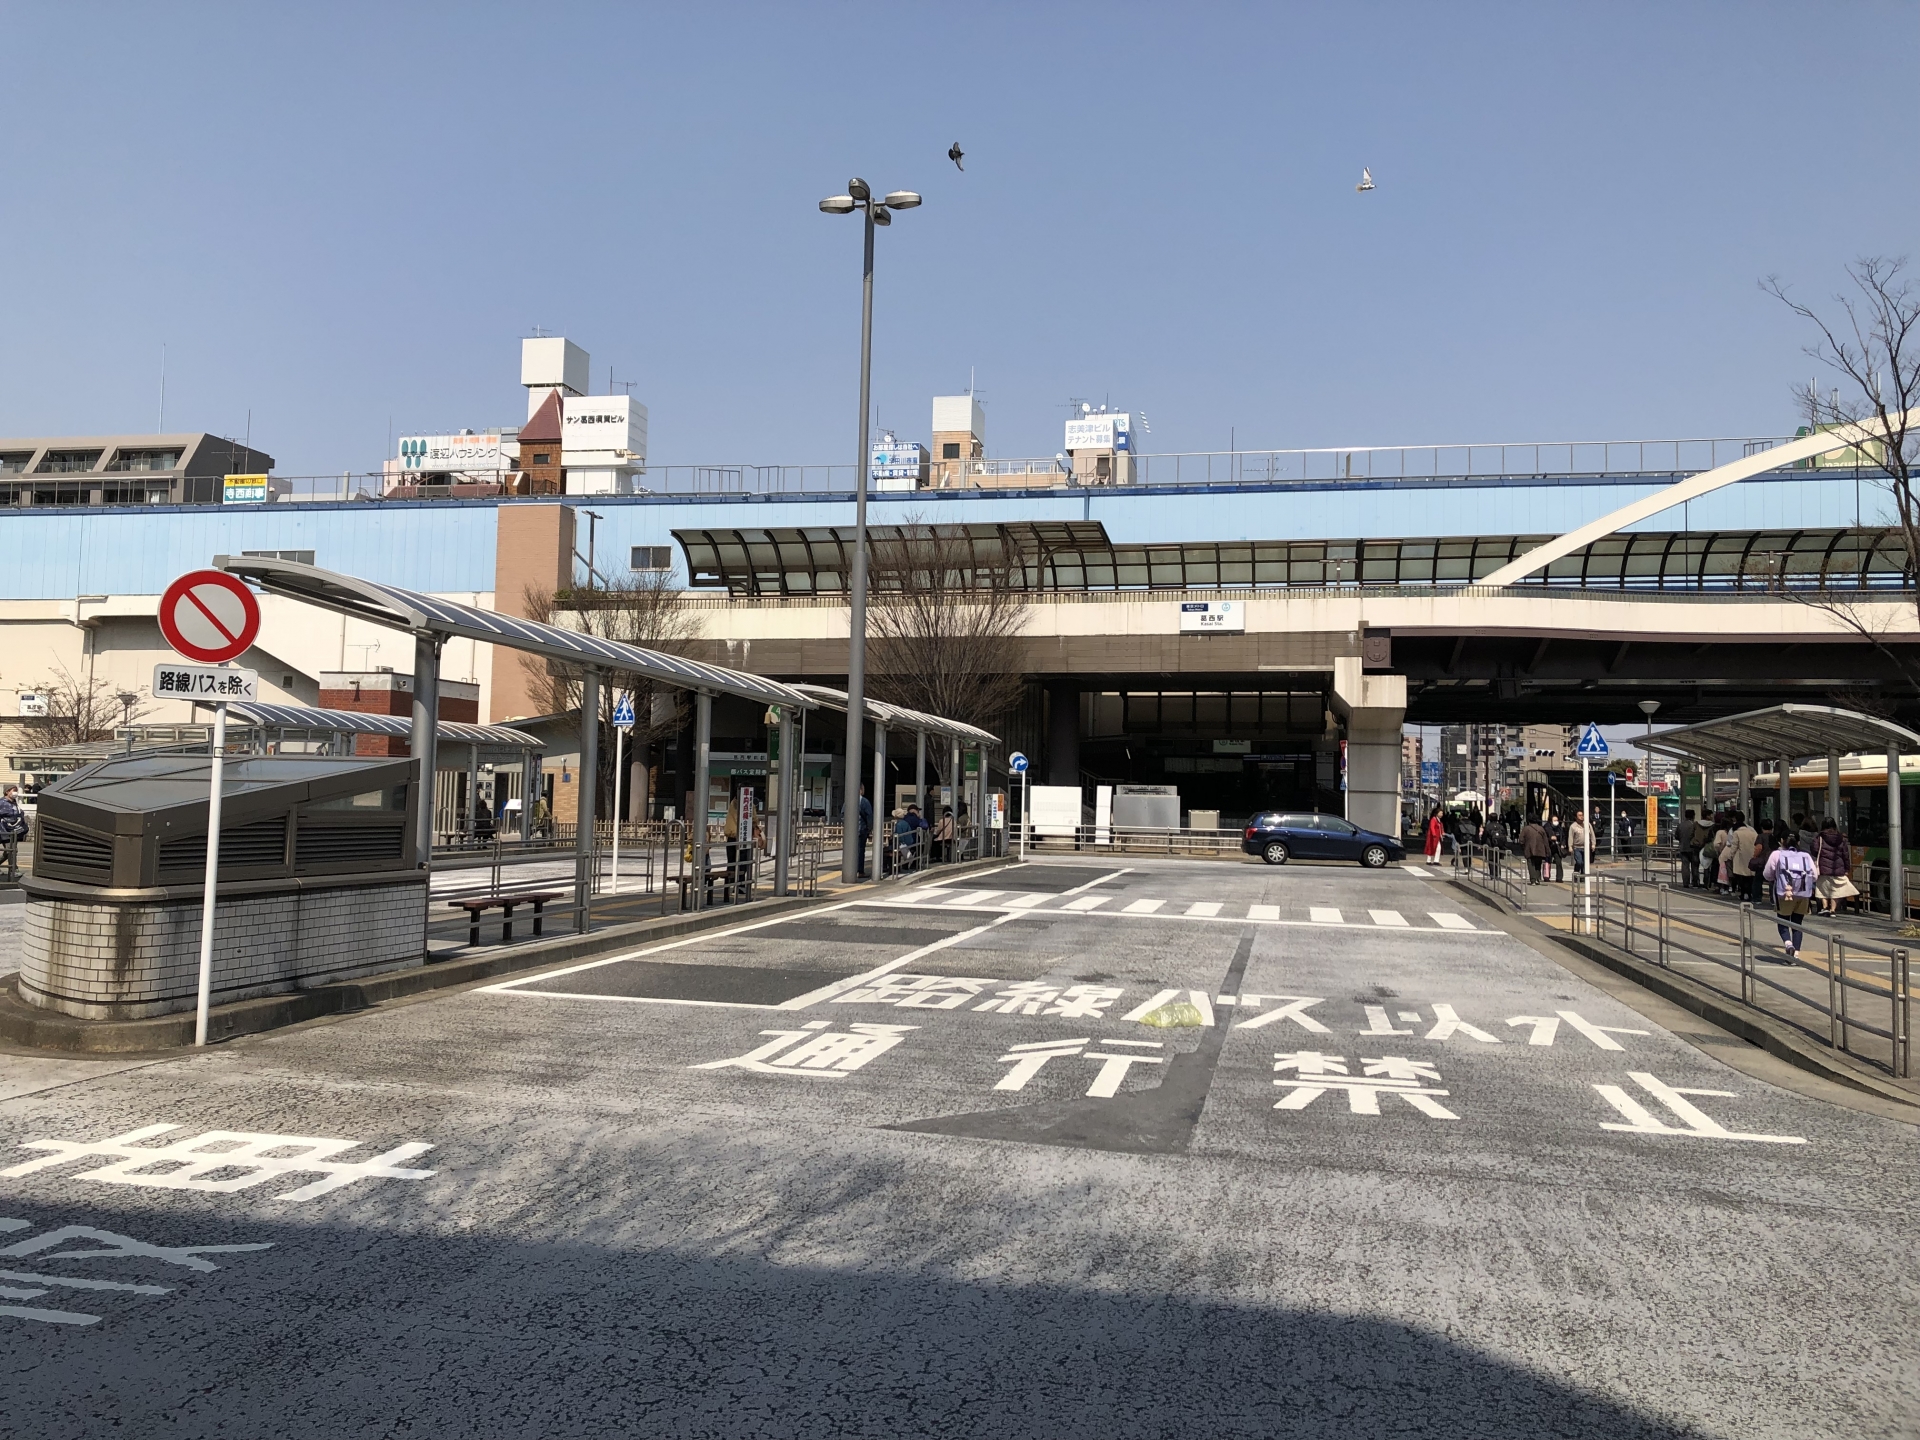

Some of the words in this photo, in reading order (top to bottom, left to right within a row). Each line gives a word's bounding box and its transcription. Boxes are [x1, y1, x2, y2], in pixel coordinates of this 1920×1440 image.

[1068, 424, 1111, 434] 志美津ビル
[1068, 434, 1111, 444] テナント募集
[430, 447, 498, 459] 渡辺ハウジング
[225, 487, 265, 499] 寺西商事
[1200, 614, 1224, 622] 葛西駅
[158, 670, 253, 697] 路線バスを除く
[829, 973, 1652, 1052] 路線バス以外
[686, 1020, 1808, 1143] 通行禁止
